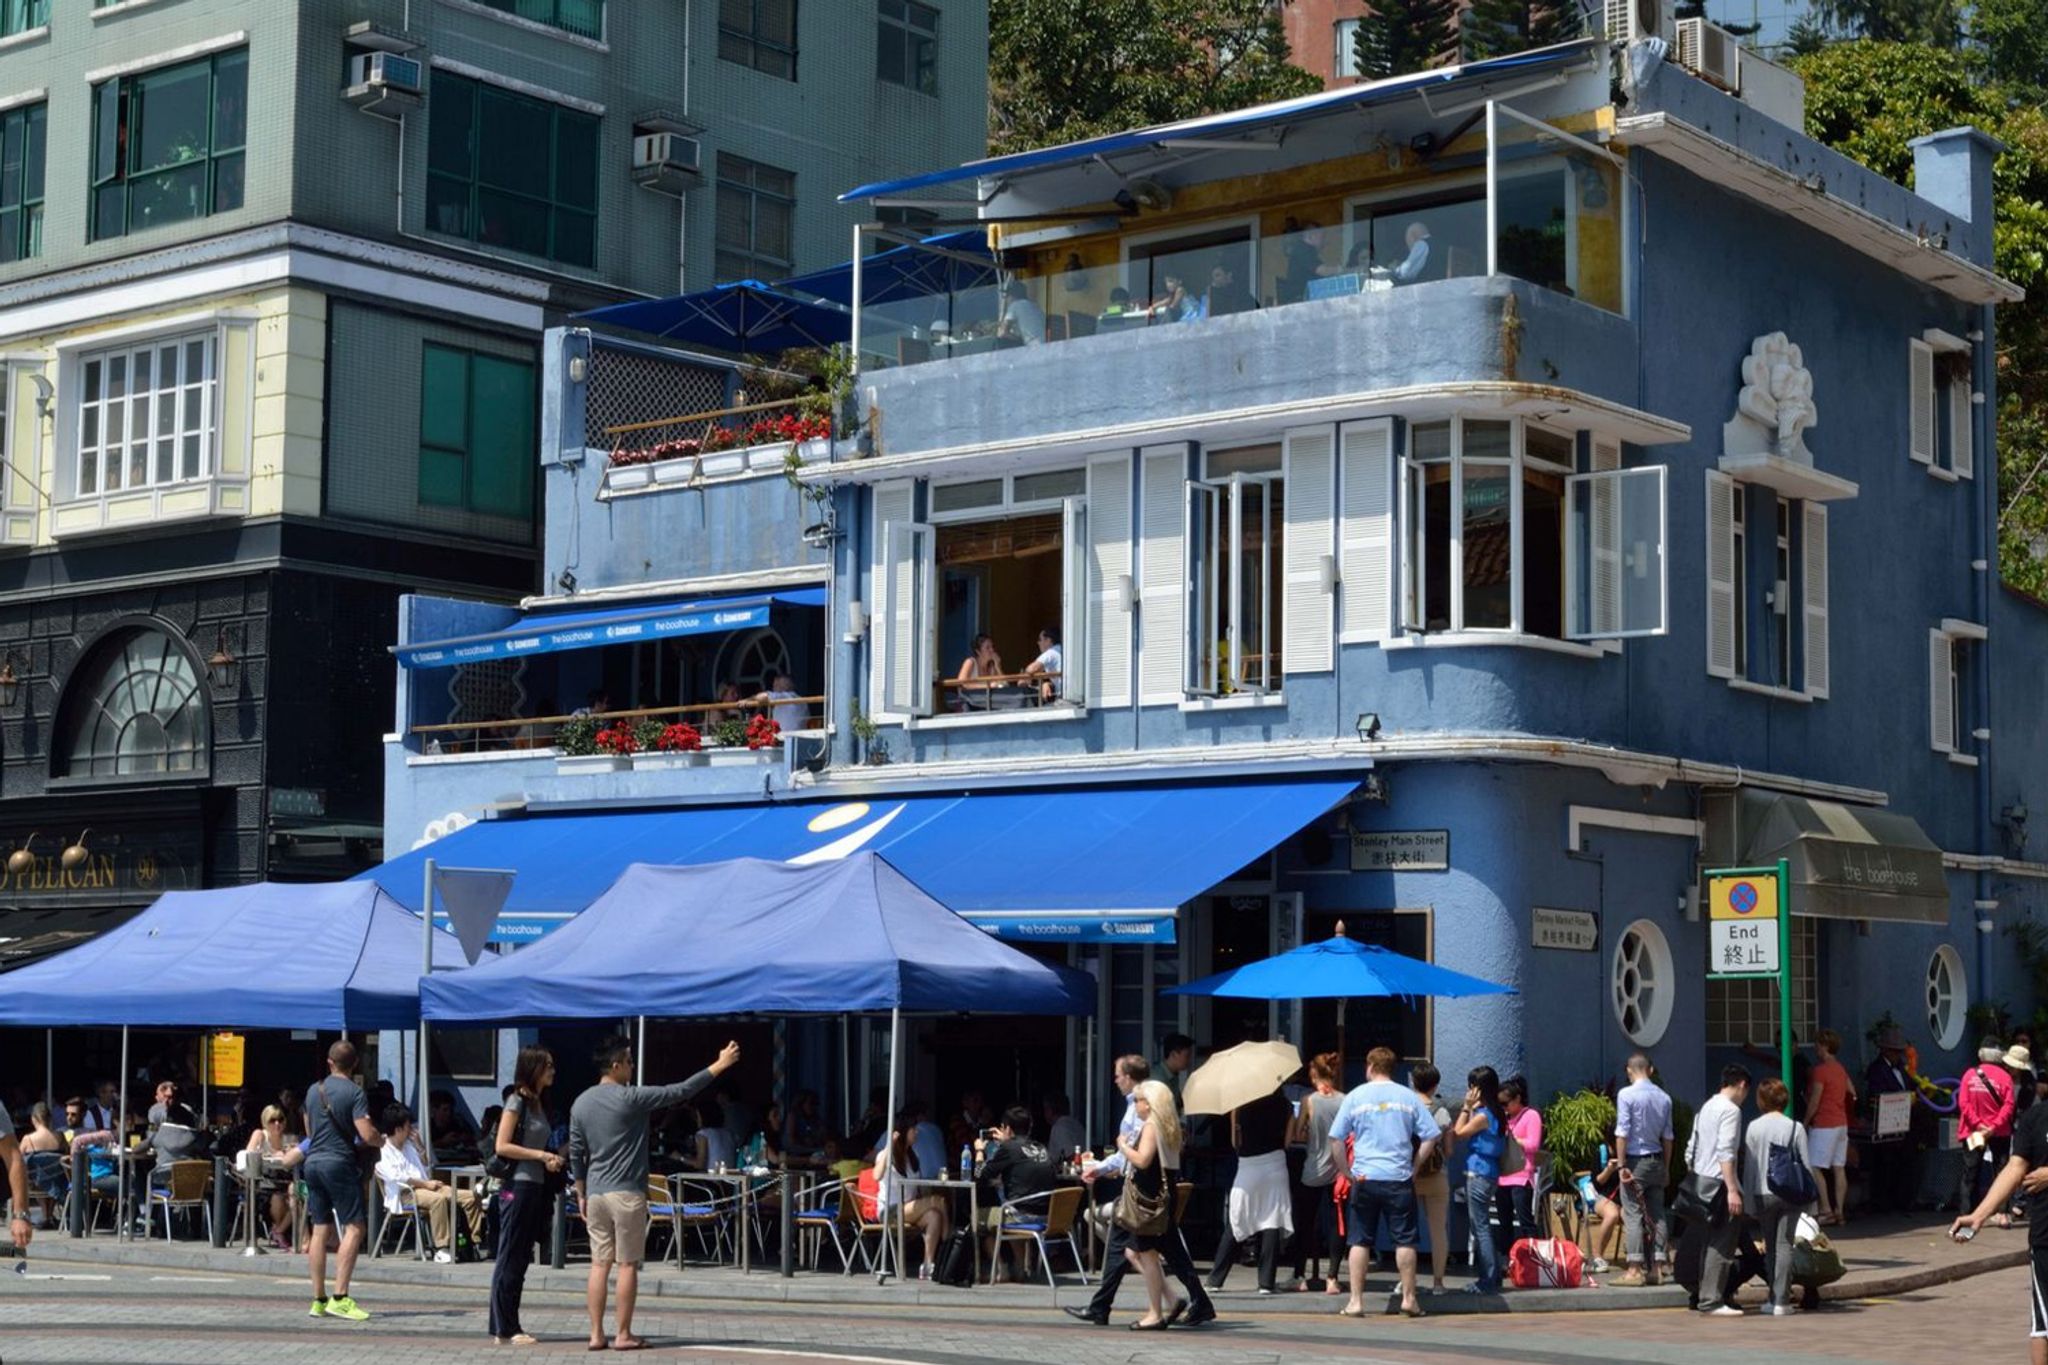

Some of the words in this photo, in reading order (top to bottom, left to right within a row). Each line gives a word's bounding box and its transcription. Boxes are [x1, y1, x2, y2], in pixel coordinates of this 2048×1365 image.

[1390, 835, 1413, 846] Main
[1415, 834, 1444, 846] Street
[1729, 925, 1759, 939] End
[1723, 943, 1766, 966] 終止
